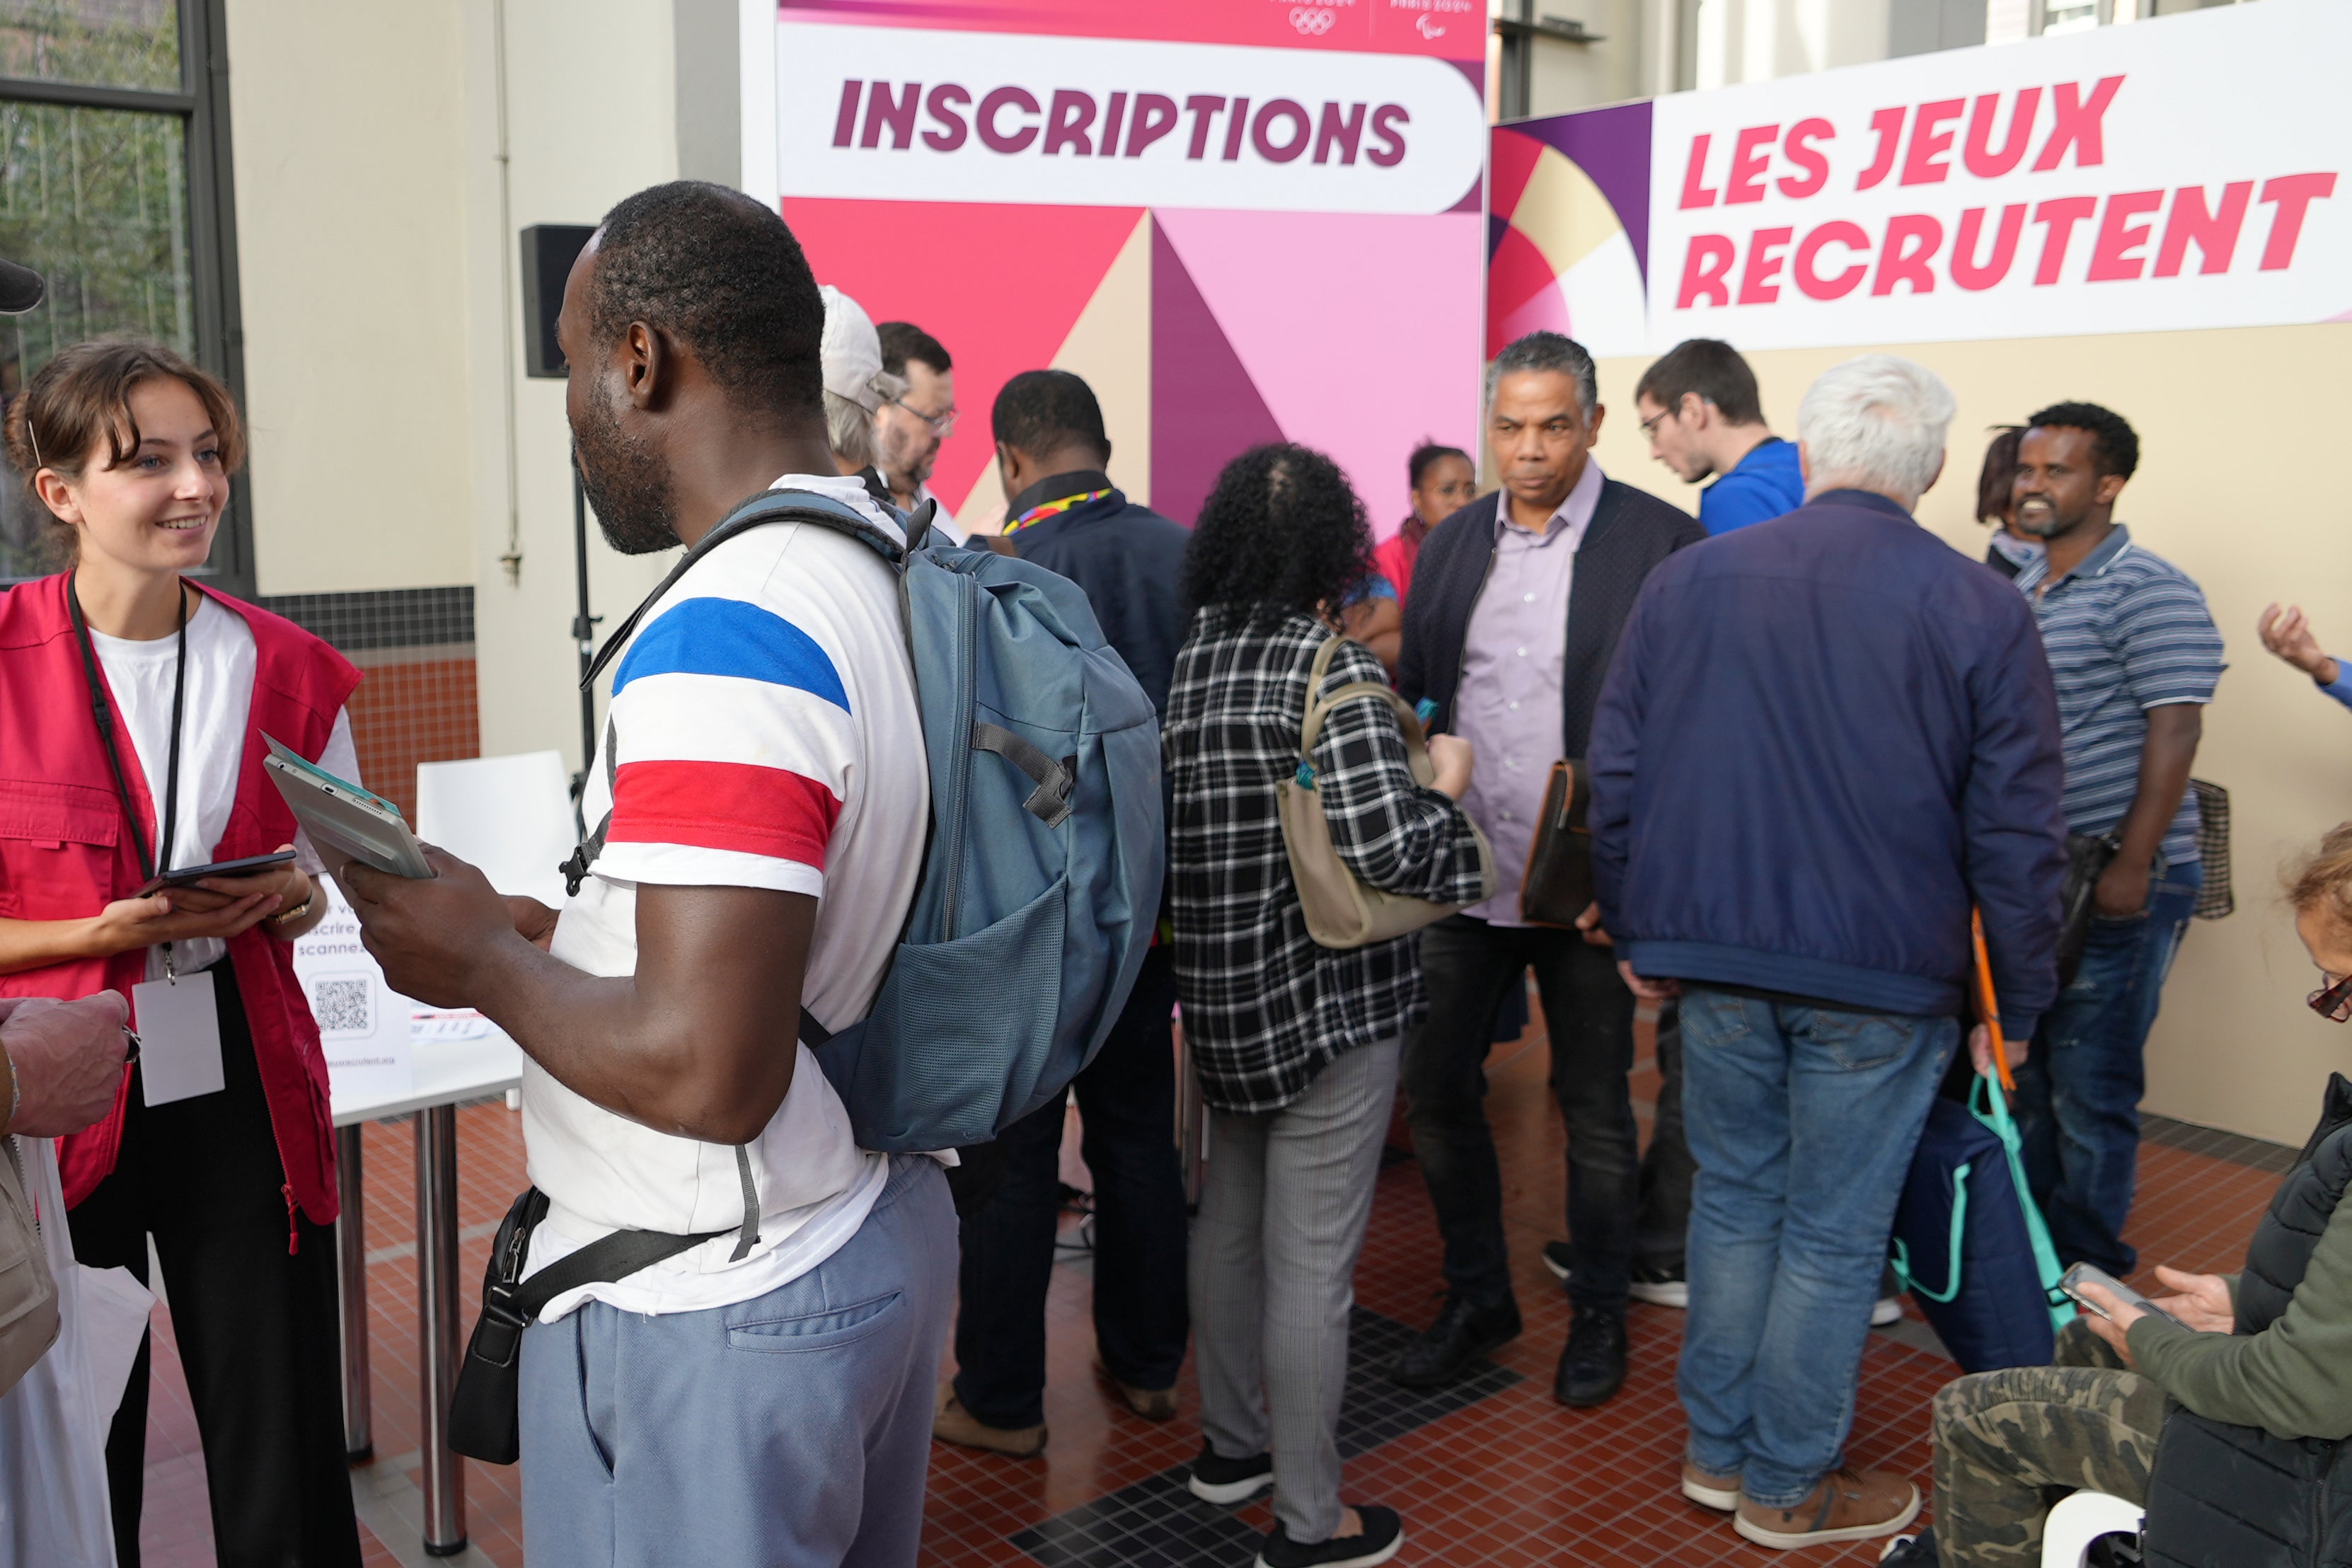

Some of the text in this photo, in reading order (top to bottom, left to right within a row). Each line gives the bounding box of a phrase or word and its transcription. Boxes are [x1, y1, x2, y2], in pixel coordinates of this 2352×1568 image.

[831, 79, 1411, 169] INSCRIPTIONS
[1678, 74, 2126, 212] LES JEUX
[1675, 172, 2339, 310] RECRUTENT
